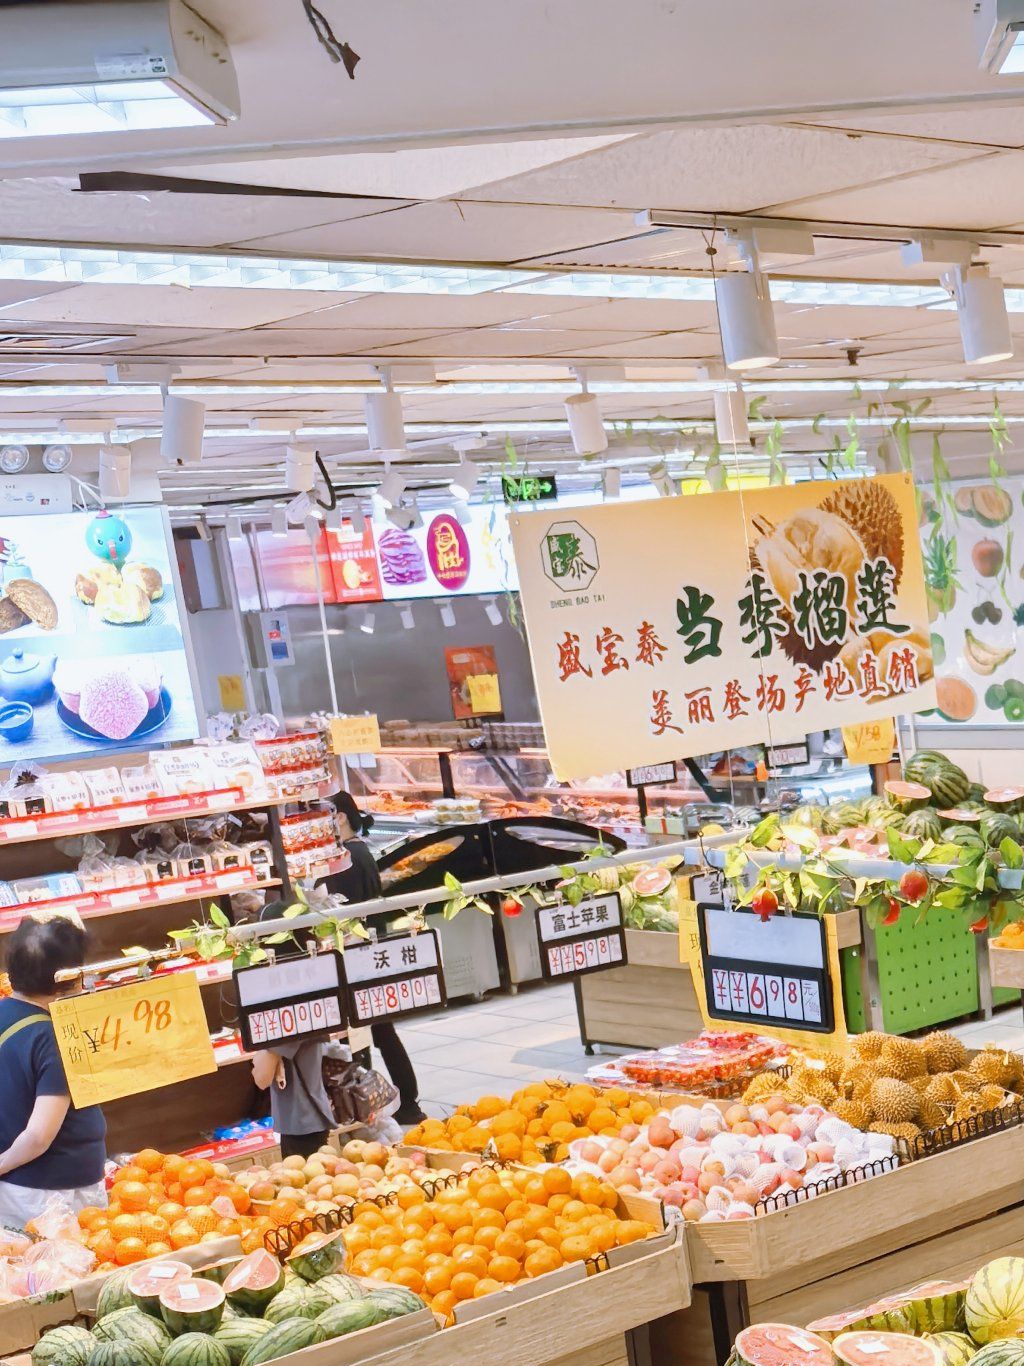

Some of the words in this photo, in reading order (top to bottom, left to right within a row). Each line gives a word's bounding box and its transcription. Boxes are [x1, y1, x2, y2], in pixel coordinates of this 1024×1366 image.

[557, 621, 667, 682] 盛宝泰
[676, 560, 911, 665] 当季榴莲
[648, 648, 920, 736] 美丽登场产地直销
[552, 904, 609, 934] 富士苹果
[373, 946, 417, 970] 沃柑
